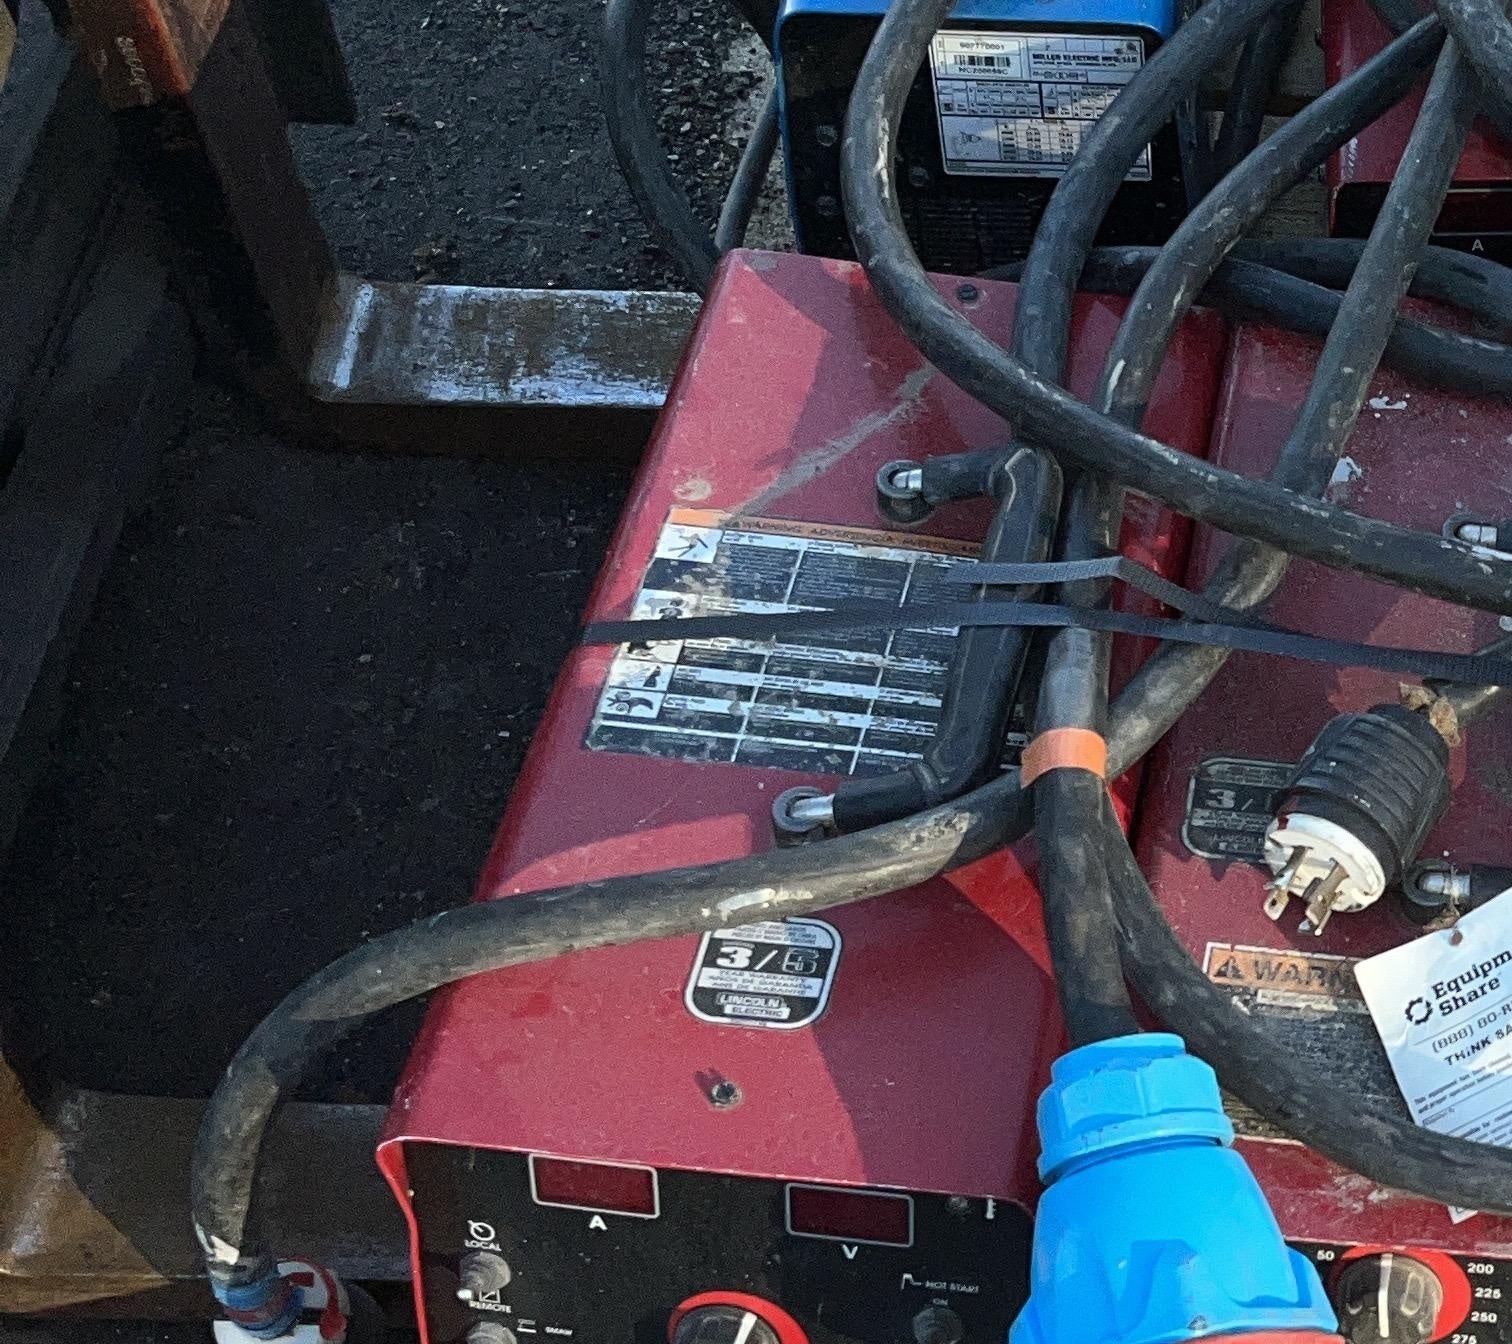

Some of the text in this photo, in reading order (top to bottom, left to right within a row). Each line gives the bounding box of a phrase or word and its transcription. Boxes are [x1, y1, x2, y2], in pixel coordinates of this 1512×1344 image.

[1471, 239, 1485, 252] A
[719, 994, 781, 1008] LINCOLN
[1439, 972, 1502, 1017] Share
[1432, 1024, 1475, 1054] (888)
[1443, 1033, 1492, 1067] THINK
[588, 1214, 608, 1231] A
[464, 1239, 502, 1252] LOCAL
[841, 1243, 859, 1260] V
[1316, 1249, 1336, 1261] 50
[1467, 1262, 1495, 1275] 200
[1474, 1287, 1502, 1300] 225
[469, 1300, 512, 1314] REMOTE
[1470, 1311, 1498, 1324] 250
